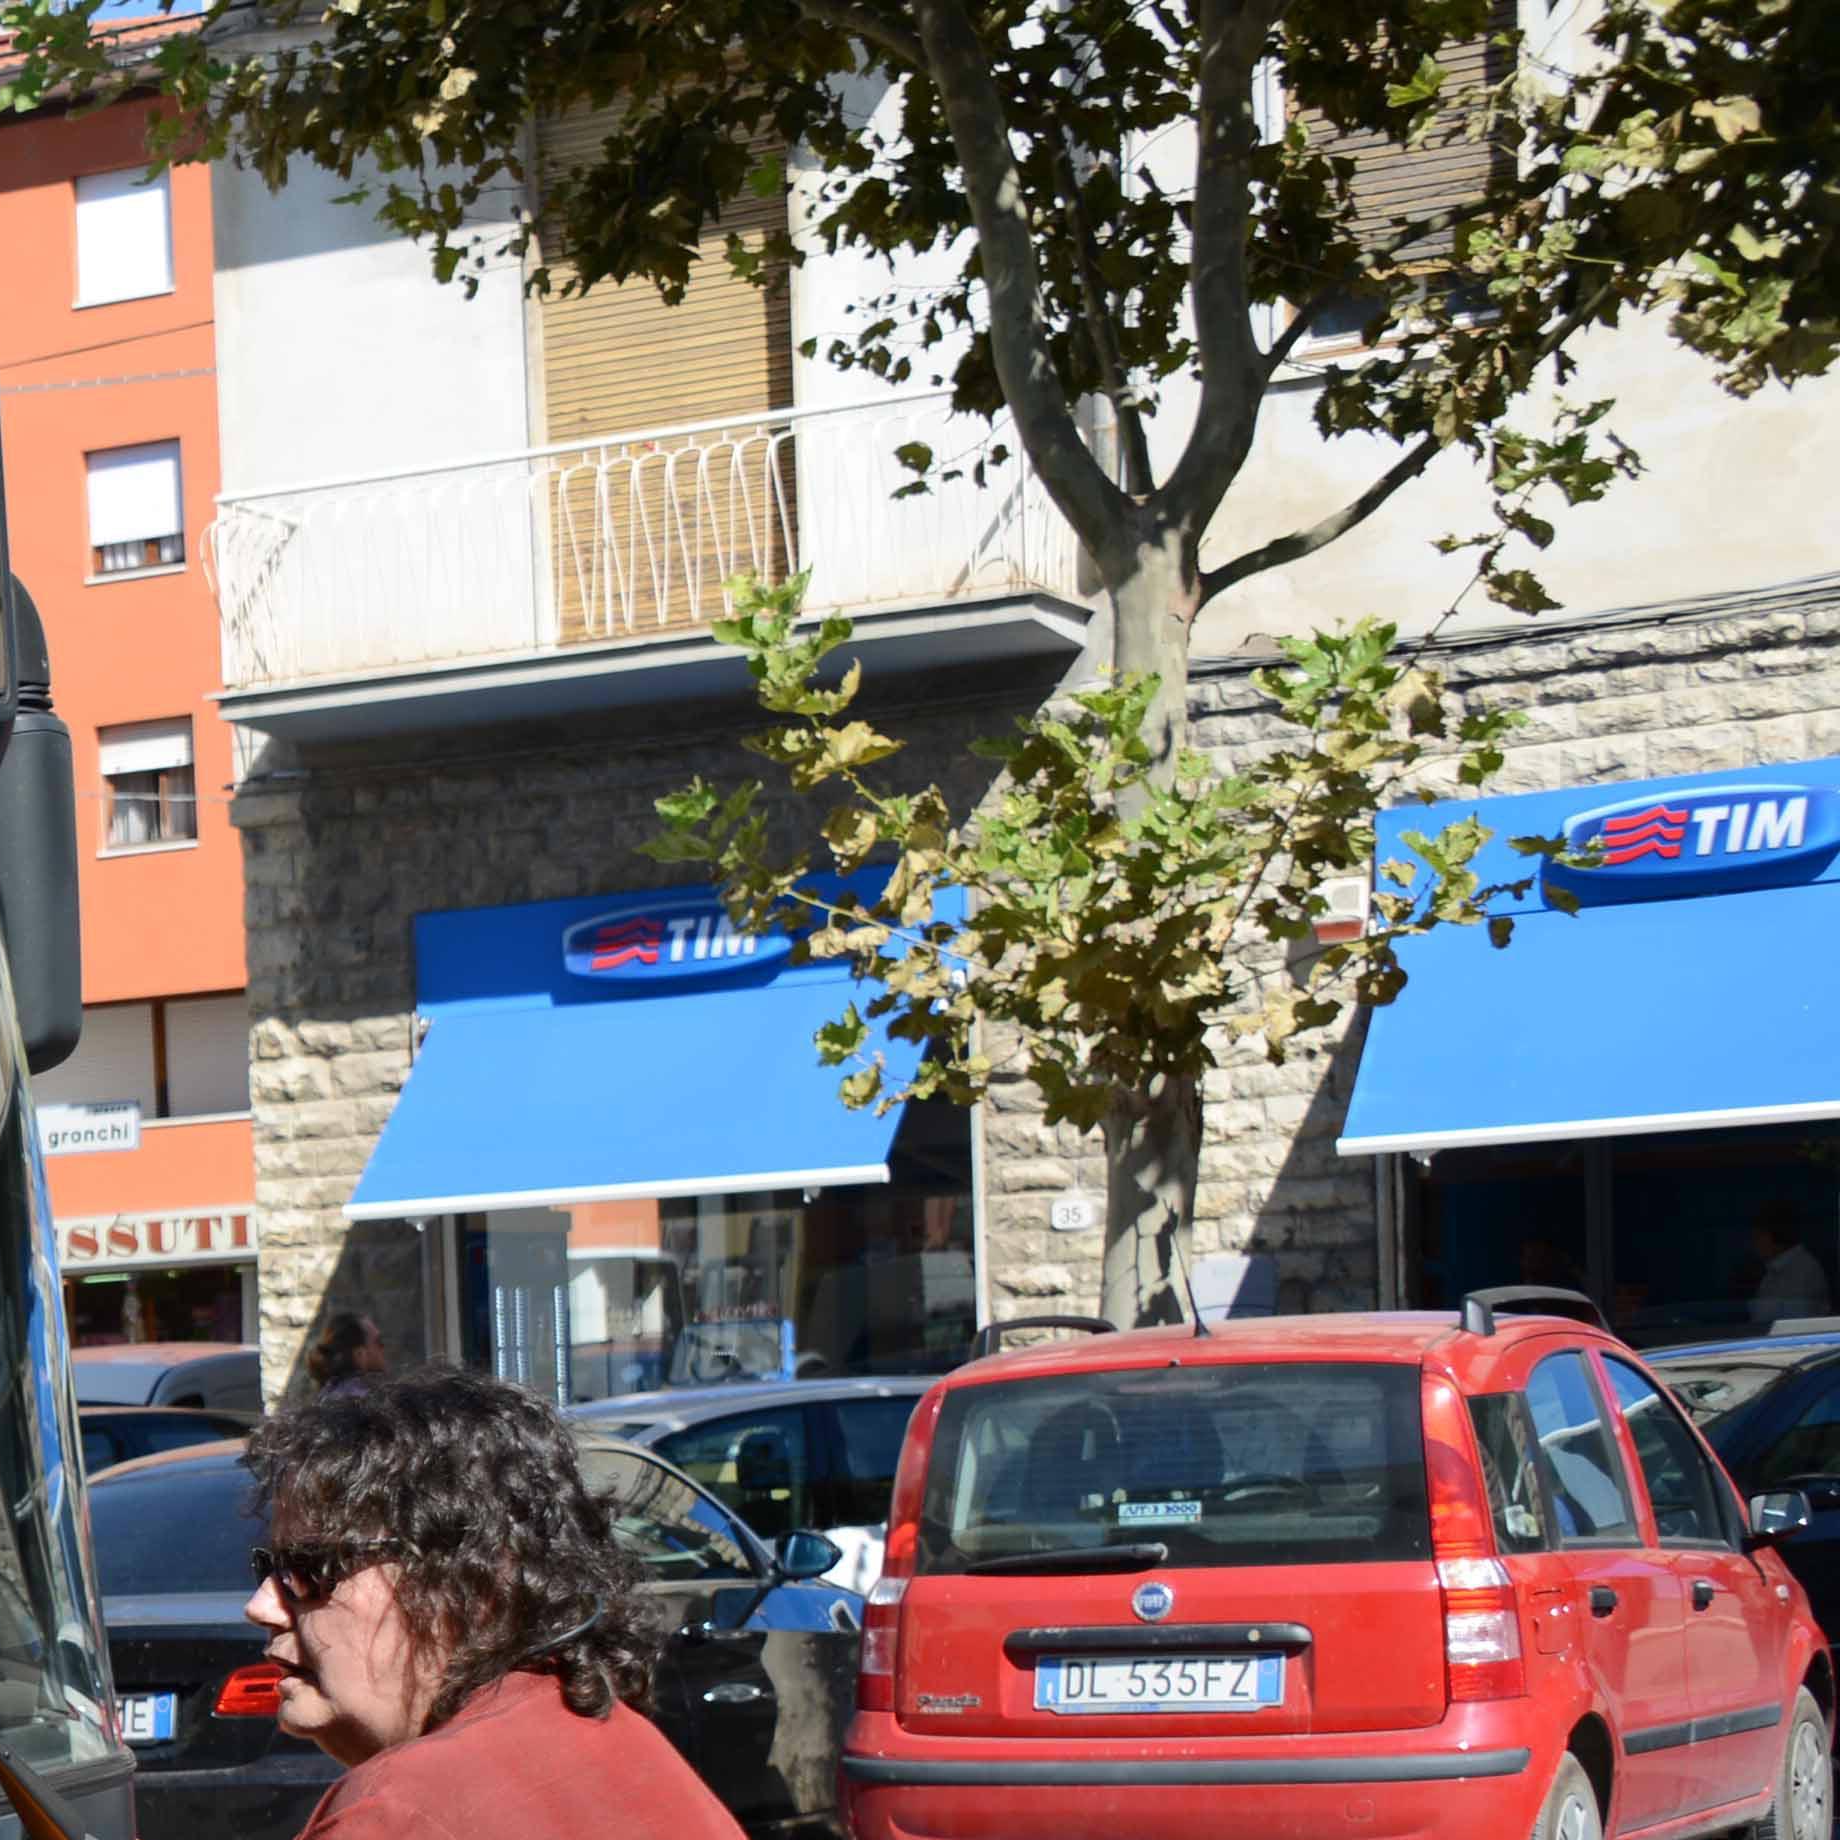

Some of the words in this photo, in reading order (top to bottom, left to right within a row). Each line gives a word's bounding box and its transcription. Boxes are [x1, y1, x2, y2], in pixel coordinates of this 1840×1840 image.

[1692, 796, 1808, 857] TIM
[666, 915, 757, 962] TIM
[47, 1123, 129, 1149] gronchi
[54, 1214, 250, 1261] SSUTI
[1059, 1206, 1083, 1226] 35
[1065, 1660, 1108, 1699] DL
[1127, 1659, 1252, 1698] 535FZ
